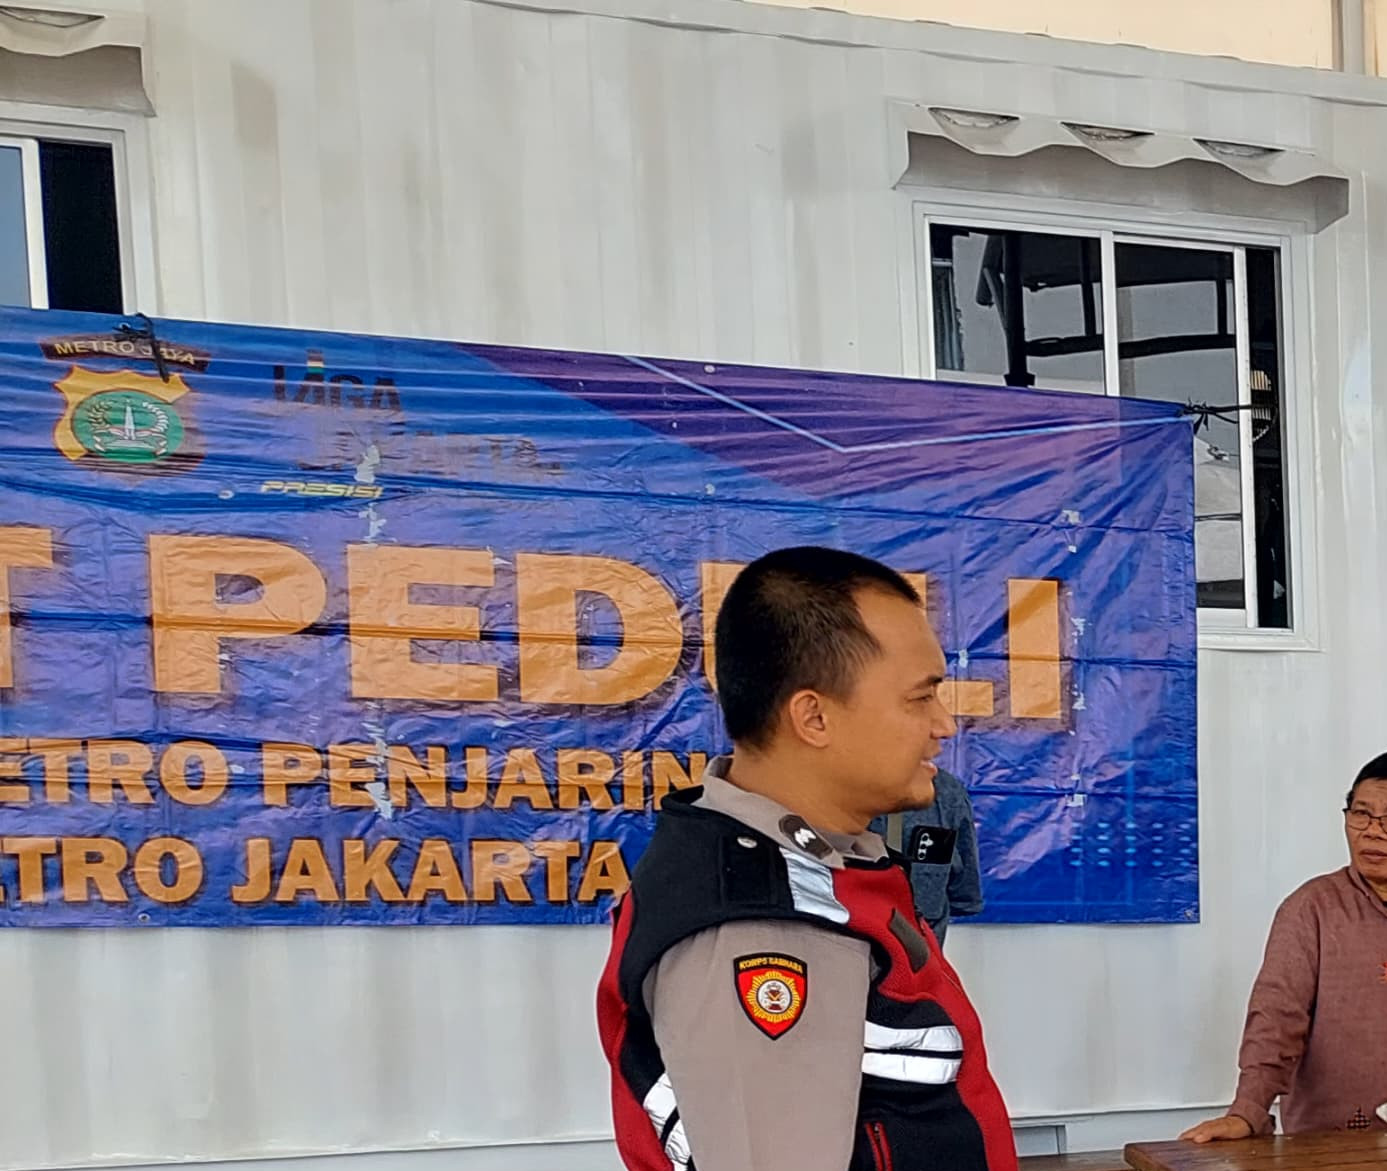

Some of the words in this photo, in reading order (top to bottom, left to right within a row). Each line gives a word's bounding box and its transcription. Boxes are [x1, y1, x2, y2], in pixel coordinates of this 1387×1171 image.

[54, 340, 134, 355] METRO
[261, 480, 384, 499] PRESISI
[231, 836, 632, 904] JAKARTA
